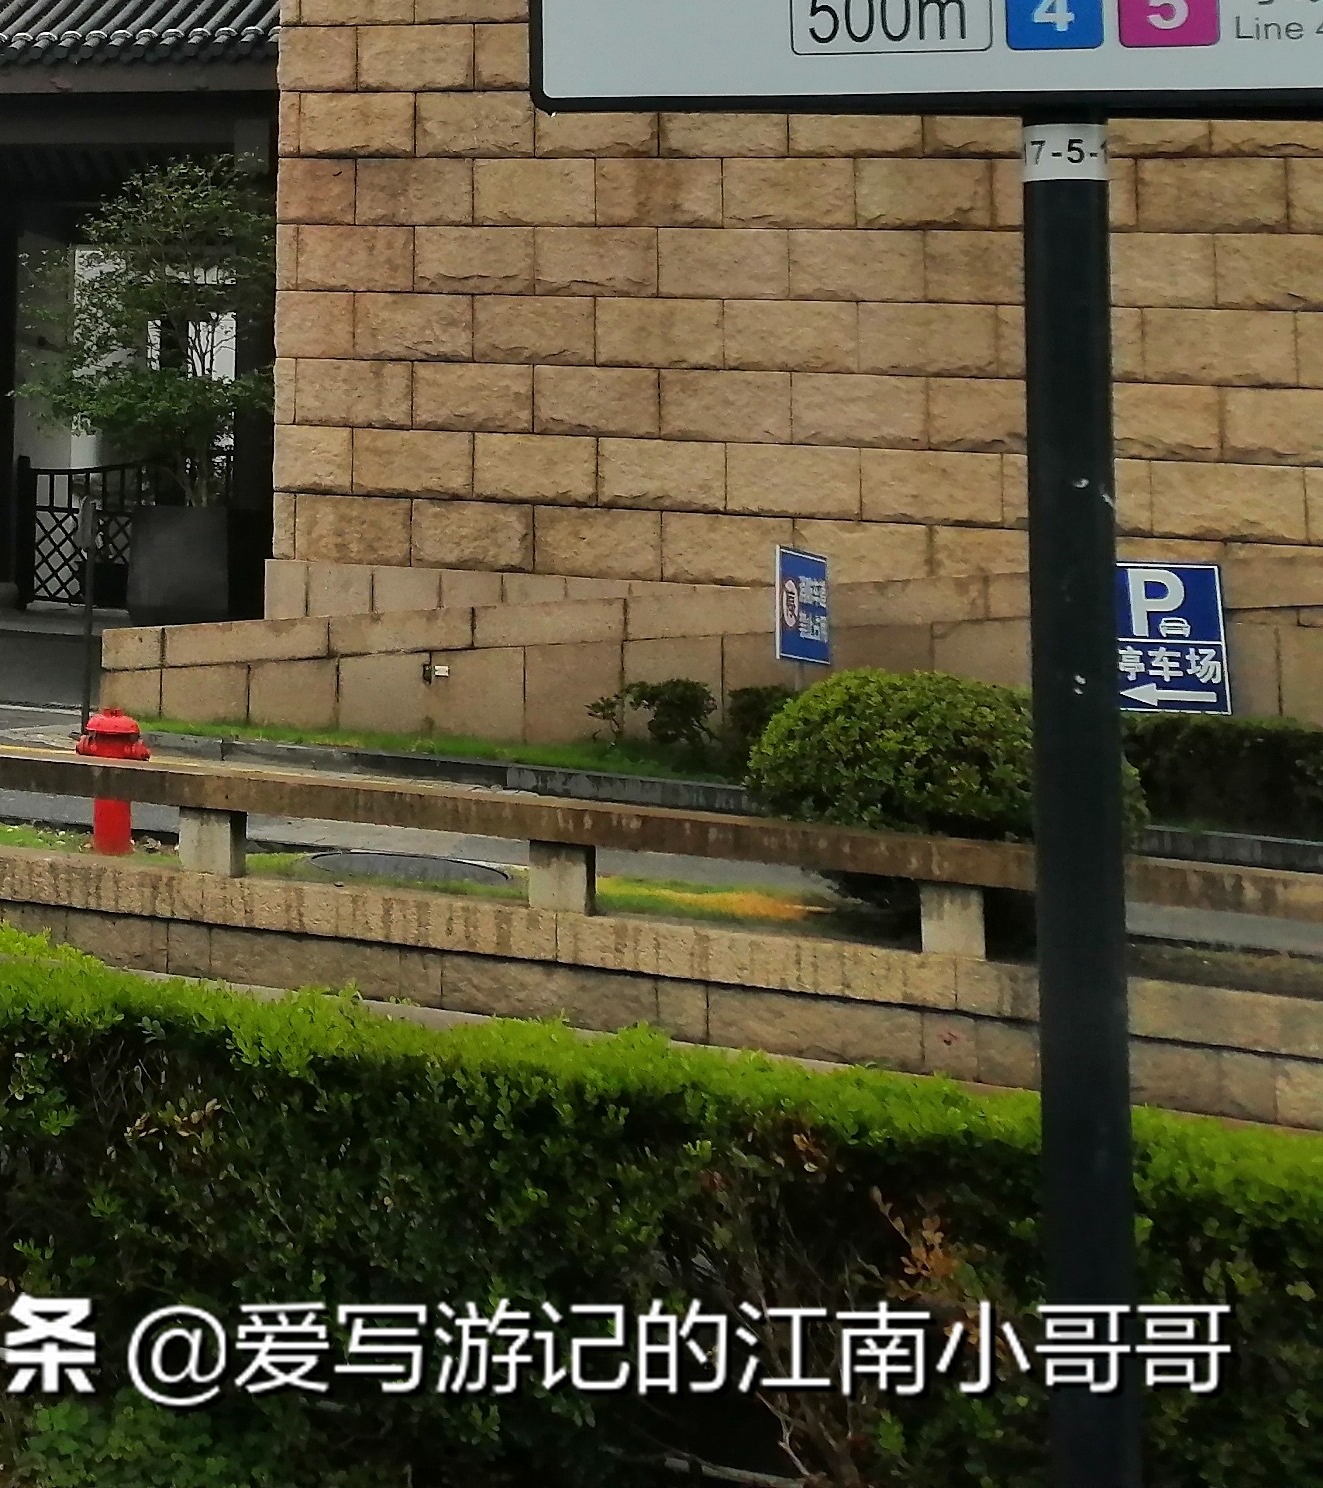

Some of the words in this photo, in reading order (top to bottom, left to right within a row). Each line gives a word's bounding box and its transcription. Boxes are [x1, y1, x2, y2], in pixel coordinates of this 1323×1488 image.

[1235, 16, 1304, 40] Line
[1127, 568, 1185, 637] P
[1118, 645, 1222, 684] 停车场
